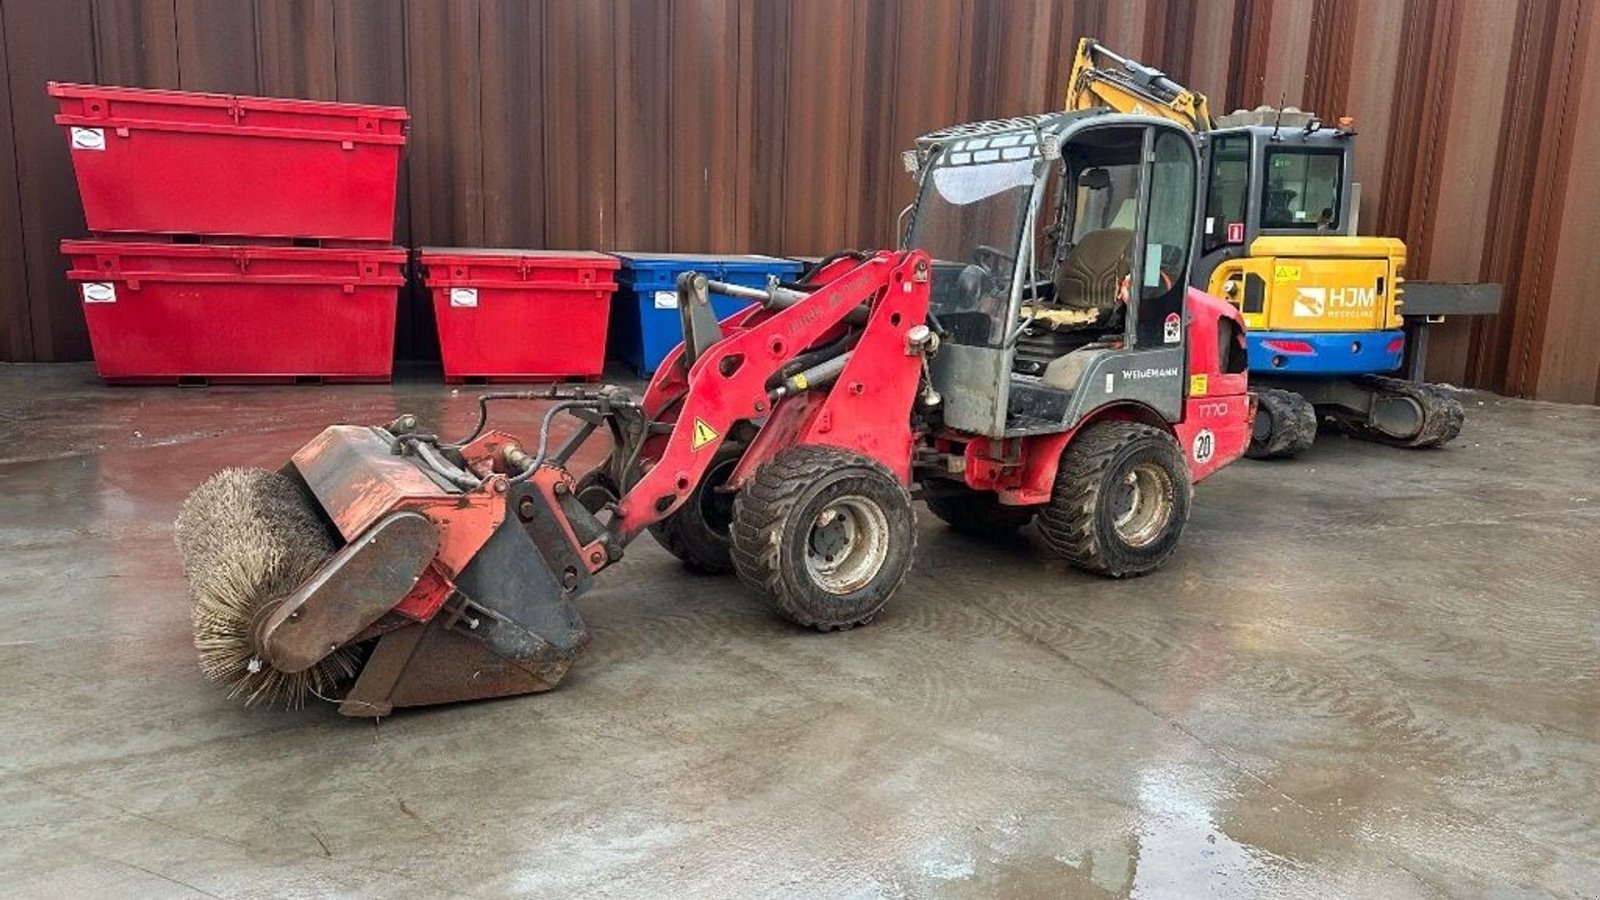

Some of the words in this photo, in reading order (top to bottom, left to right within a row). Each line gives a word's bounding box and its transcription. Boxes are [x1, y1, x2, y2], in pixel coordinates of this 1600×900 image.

[1330, 288, 1374, 308] HJM
[1121, 367, 1179, 379] WEIDEMANN
[1197, 434, 1211, 459] 20
